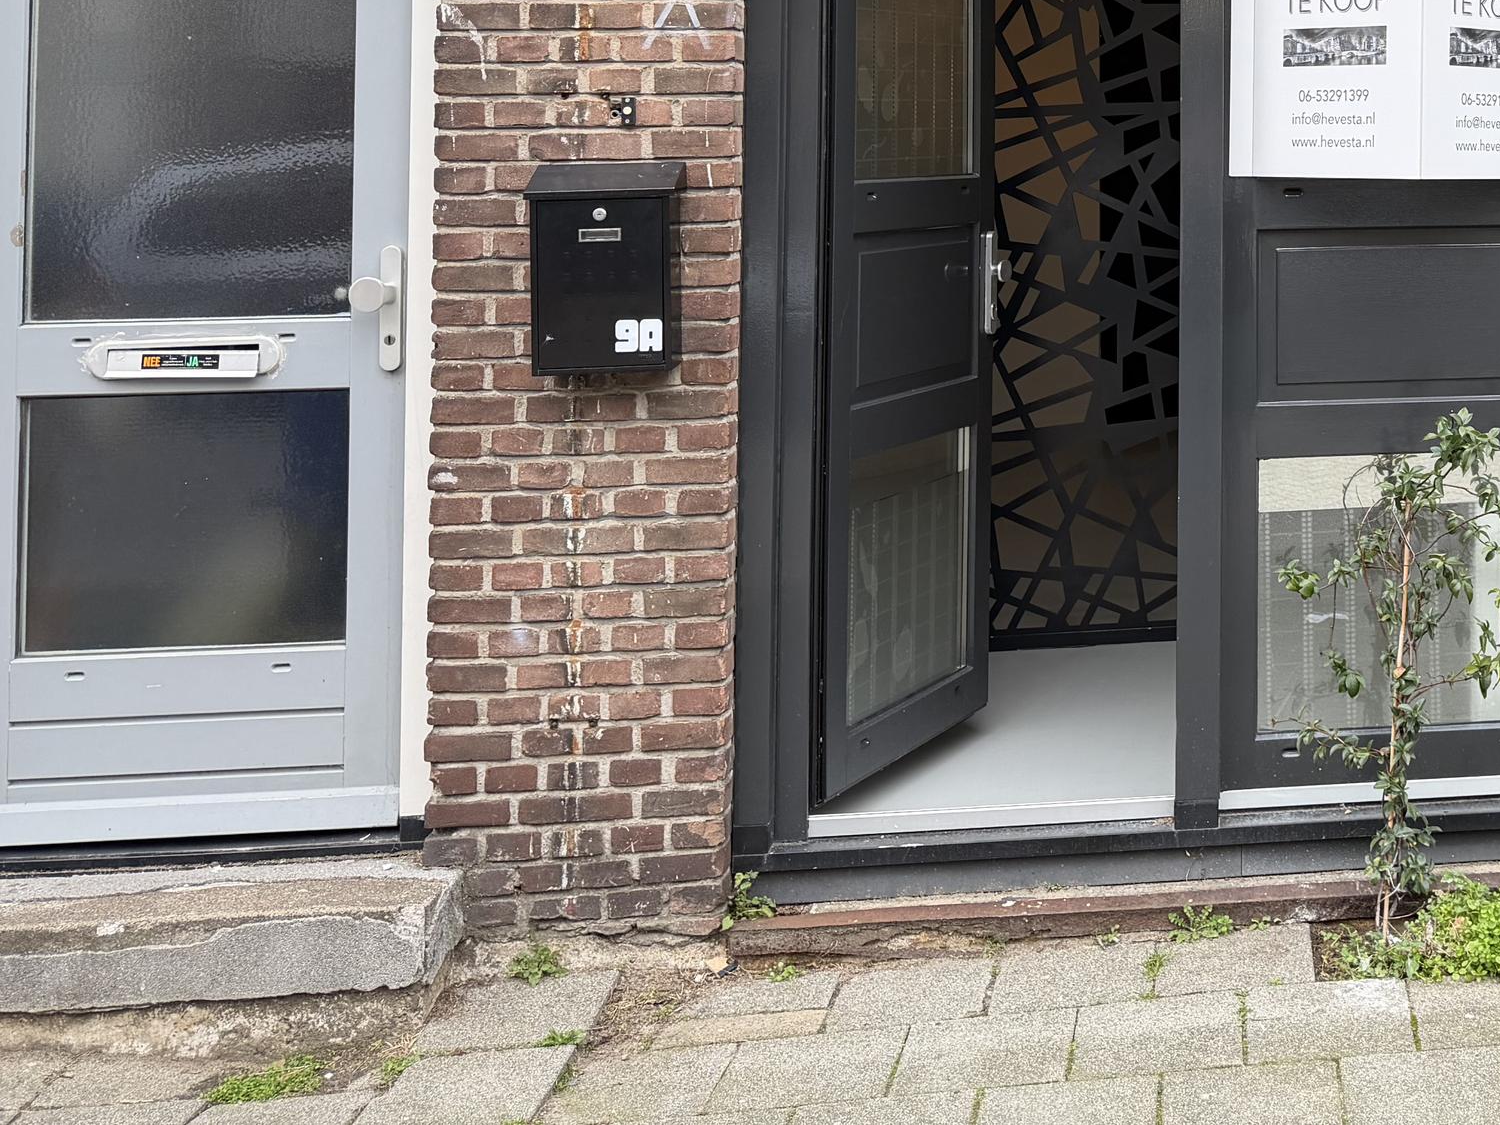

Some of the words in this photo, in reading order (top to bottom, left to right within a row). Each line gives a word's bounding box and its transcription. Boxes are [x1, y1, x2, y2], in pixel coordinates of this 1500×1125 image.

[1298, 88, 1370, 103] 06-53291399
[1291, 111, 1376, 125] info@hevesta.nl
[1291, 134, 1375, 148] www.hevesta.nl
[614, 318, 663, 353] 9A
[142, 356, 161, 367] NEE
[186, 355, 199, 367] JA
